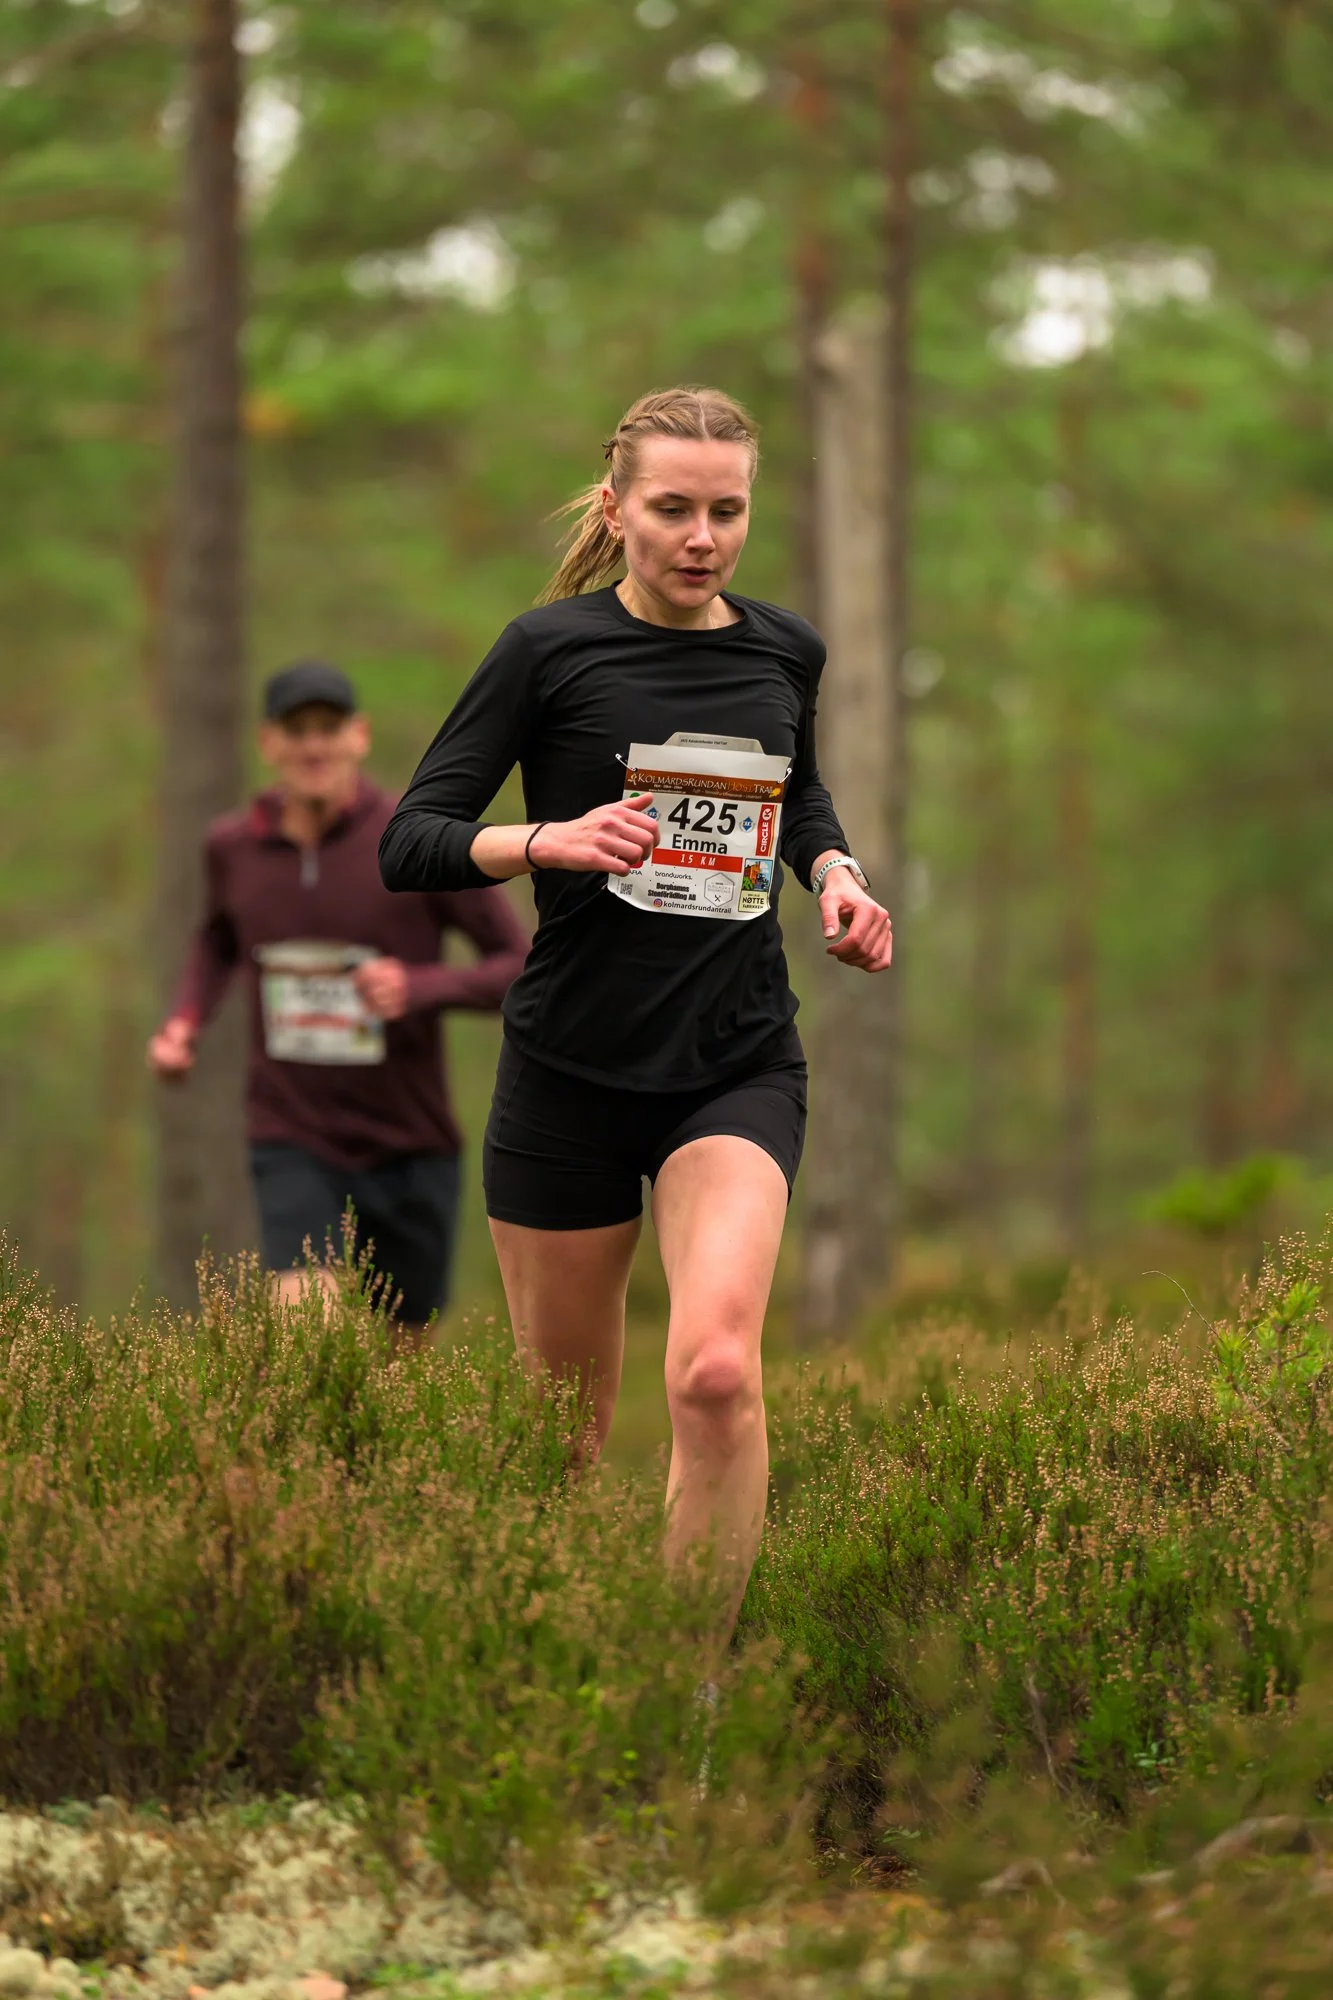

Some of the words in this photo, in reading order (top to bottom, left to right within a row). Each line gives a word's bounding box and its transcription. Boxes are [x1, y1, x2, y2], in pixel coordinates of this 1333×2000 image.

[667, 797, 739, 836] 425
[671, 834, 728, 854] Emma
[760, 820, 770, 853] CIRCLE
[663, 900, 732, 914] kolmardsrundantrail
